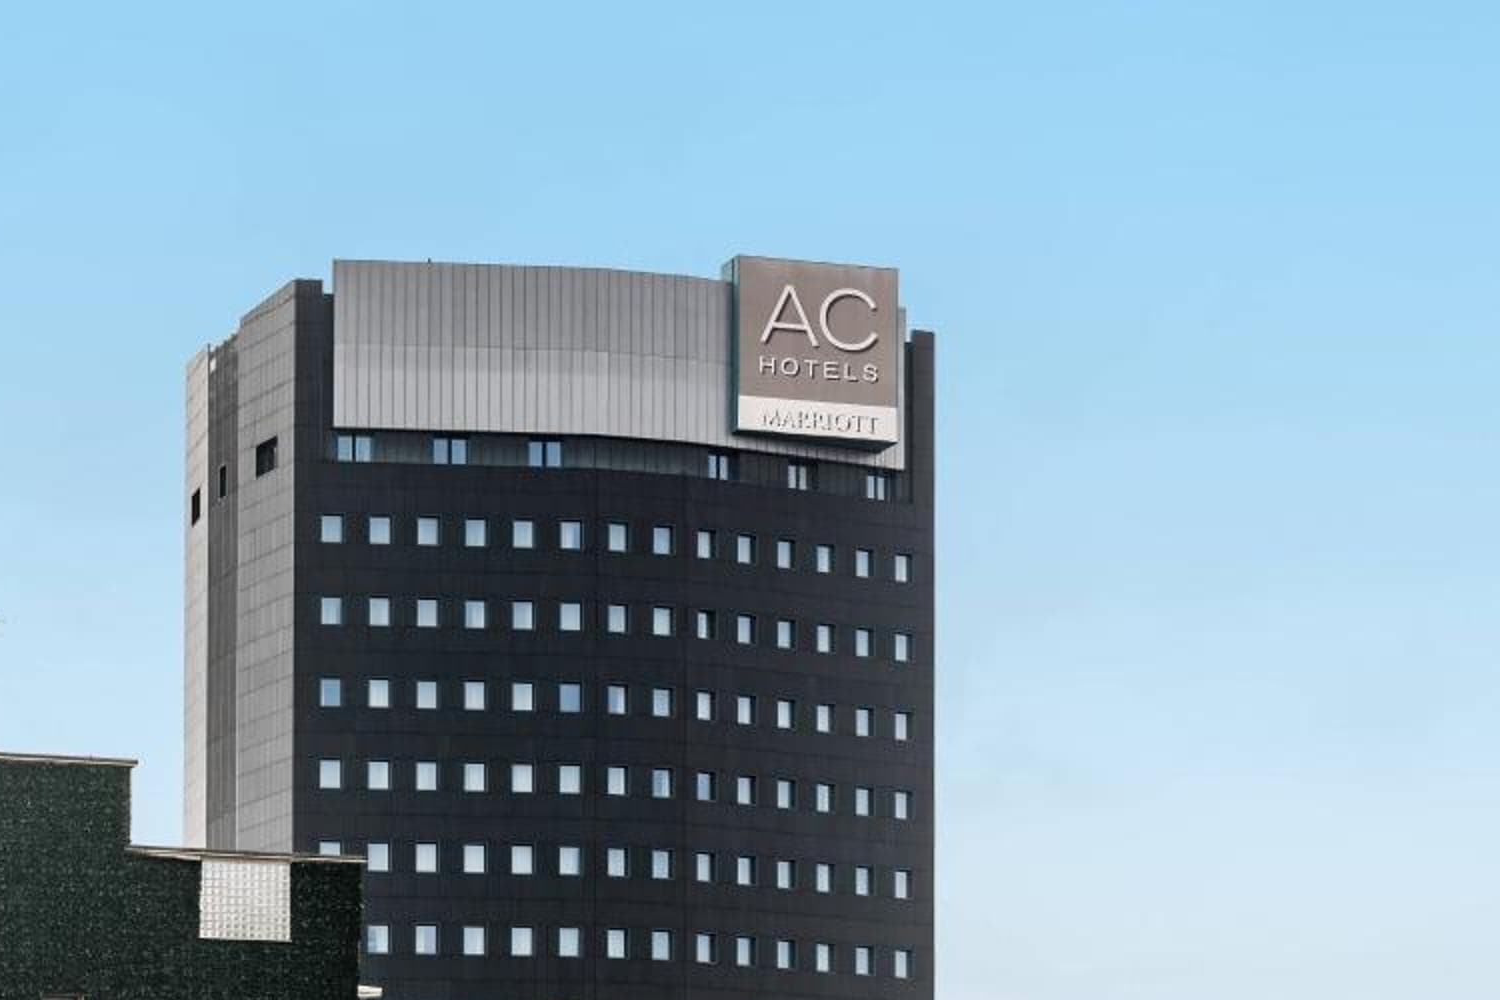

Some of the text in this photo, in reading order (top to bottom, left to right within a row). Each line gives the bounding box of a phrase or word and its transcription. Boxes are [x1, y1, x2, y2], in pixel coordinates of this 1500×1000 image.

[760, 284, 879, 353] AC
[758, 355, 880, 384] HOTELS
[761, 409, 880, 434] MARRIOTT
